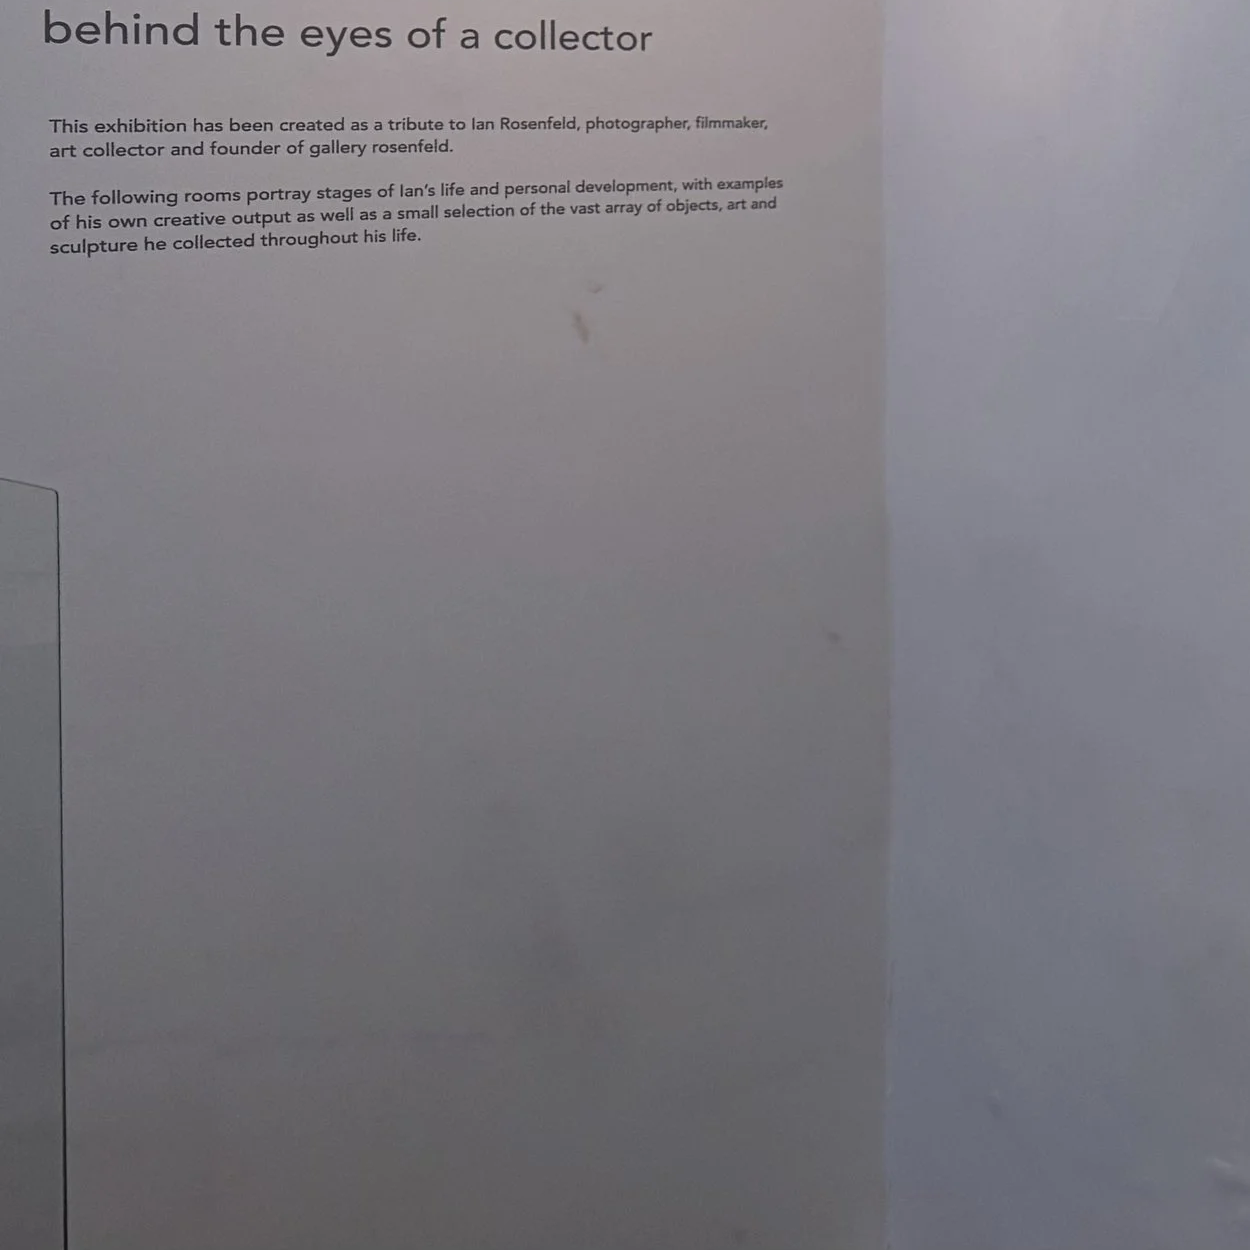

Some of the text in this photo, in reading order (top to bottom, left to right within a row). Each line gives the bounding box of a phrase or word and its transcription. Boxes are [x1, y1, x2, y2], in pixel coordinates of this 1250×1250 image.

[45, 9, 652, 56] behind the eyes of a collector
[49, 116, 767, 133] This exhibition has been created as a tribute to Ian Rosenfeld, photographer, filmmaker,
[50, 139, 453, 157] art collector and founder of gallery rosenfeld.
[49, 177, 783, 207] The following rooms portray stages of Ian's life and personal development, with examples
[50, 196, 776, 230] of his own creative output as well as a small selection of the vast array of objects, art and
[50, 228, 421, 258] sculpture he collected throughout his life.
